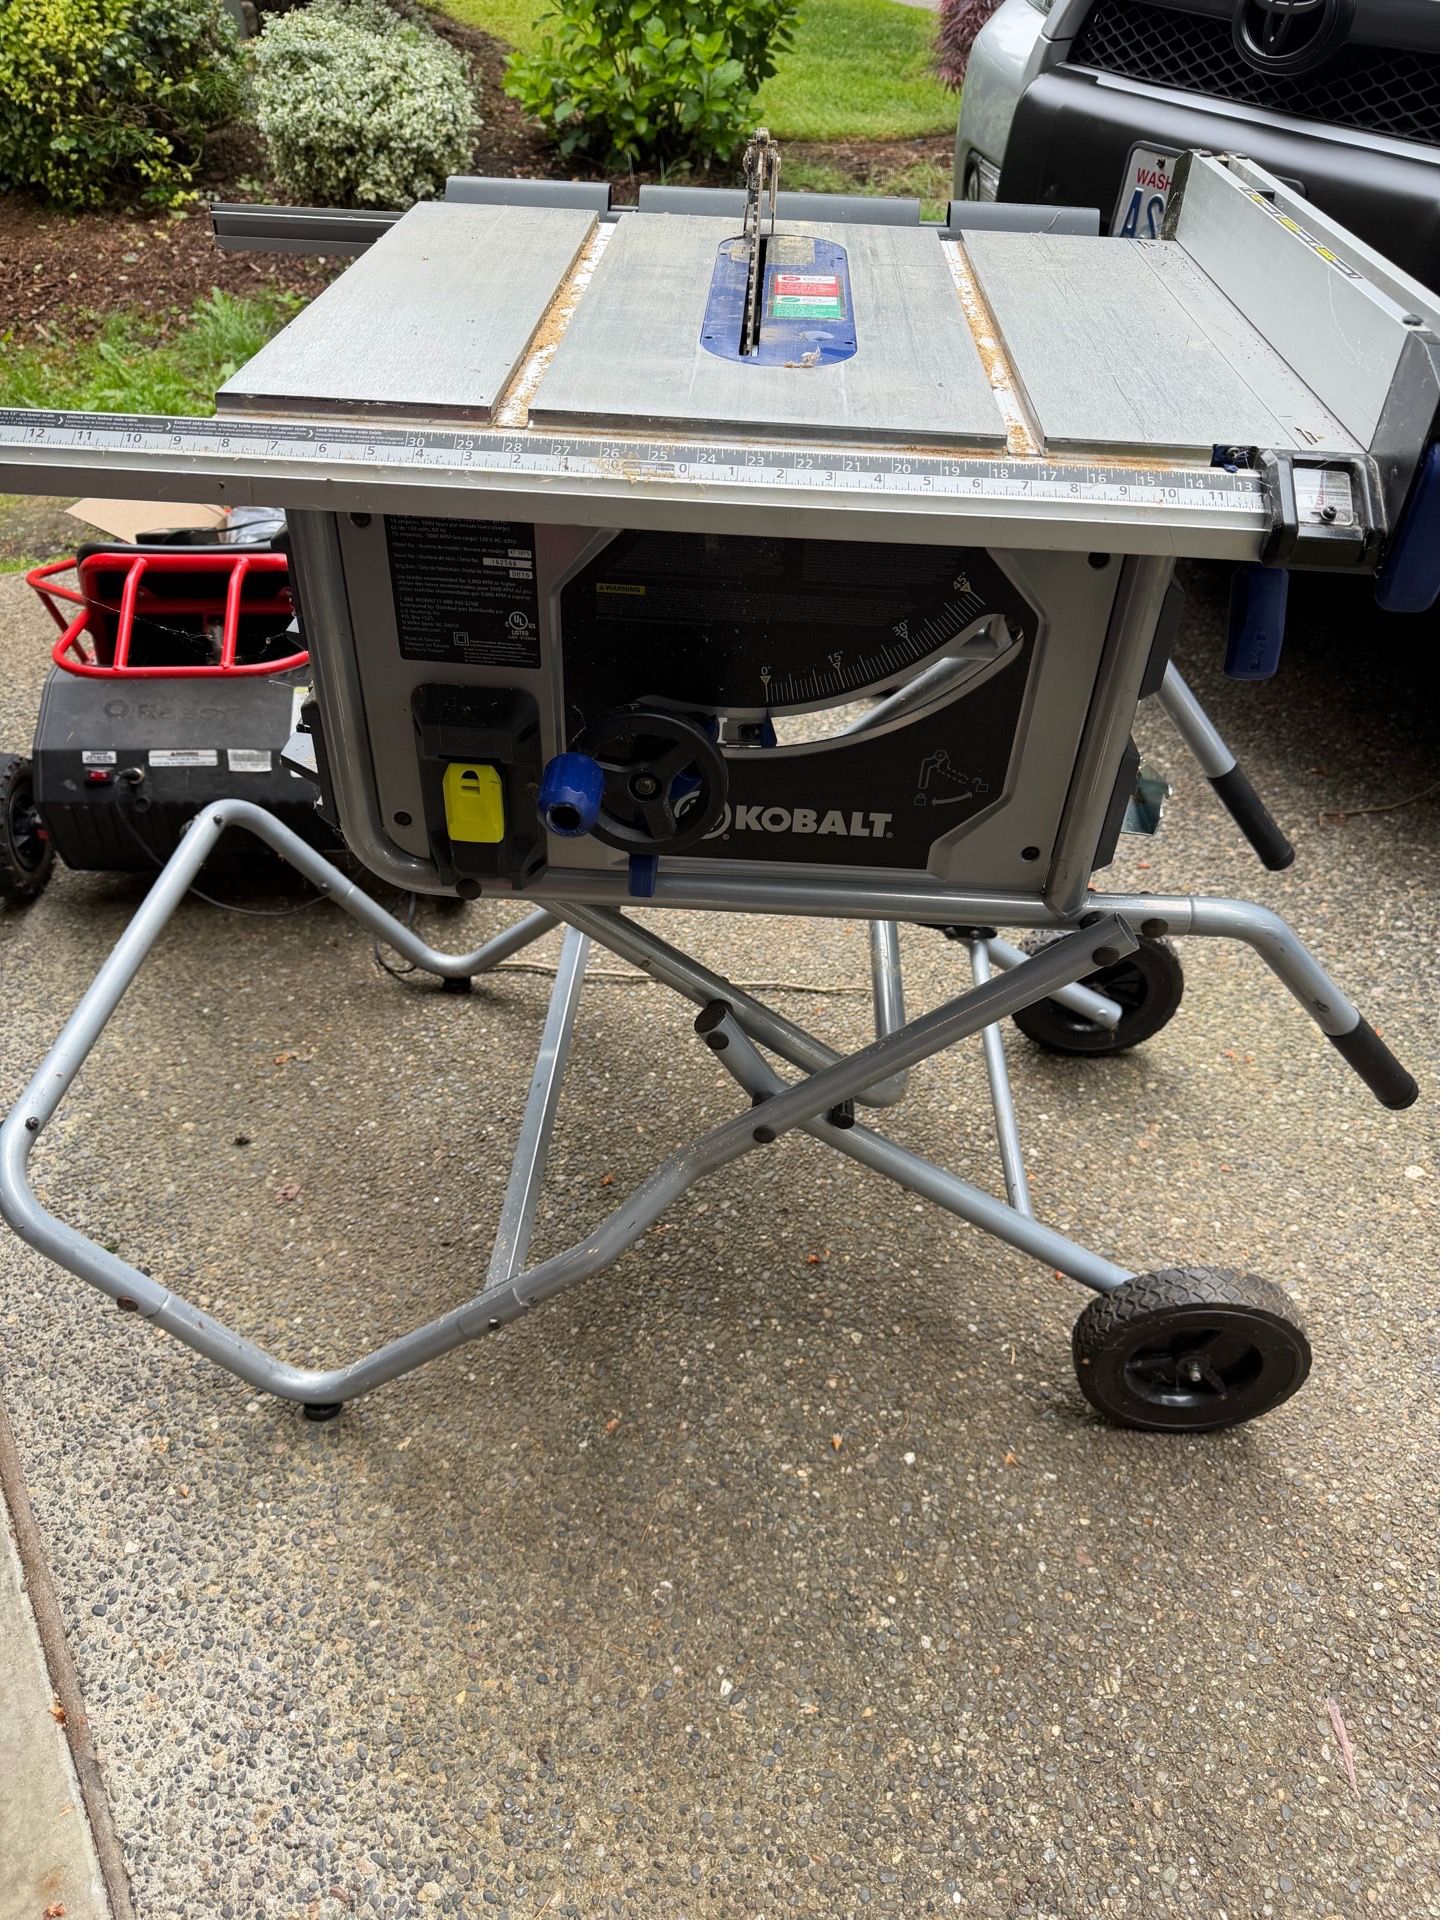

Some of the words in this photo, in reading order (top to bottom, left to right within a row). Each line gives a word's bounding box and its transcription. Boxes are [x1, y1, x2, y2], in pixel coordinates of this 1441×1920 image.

[29, 428, 45, 438] 12
[77, 431, 92, 440] 11
[125, 433, 142, 443] 10
[172, 435, 182, 445] 9
[221, 438, 230, 448] 8
[270, 440, 278, 450] 7
[318, 443, 327, 453] 6
[367, 446, 375, 455] 5
[415, 449, 424, 458] 4
[464, 451, 472, 461] 3
[512, 454, 521, 463] 2
[563, 457, 569, 465] 1
[407, 437, 425, 447] 30
[456, 440, 474, 450] 29
[504, 443, 522, 453] 28
[553, 445, 571, 455] 27
[602, 448, 619, 458] 26
[651, 451, 668, 461] 25
[699, 454, 717, 464] 24
[748, 456, 765, 466] 23
[797, 459, 813, 469] 22
[845, 461, 860, 471] 21
[894, 464, 911, 474] 20
[943, 466, 960, 476] 19
[992, 469, 1009, 478] 18
[1041, 471, 1057, 481] 17
[1090, 473, 1107, 484] 16
[1139, 476, 1156, 486] 15
[1188, 479, 1205, 489] 14
[1236, 482, 1253, 492] 13
[679, 464, 687, 473] 0
[728, 466, 734, 475] 1
[776, 469, 784, 478] 2
[825, 471, 833, 481] 3
[874, 474, 882, 483] 4
[924, 476, 931, 485] 5
[972, 479, 980, 488] 6
[1021, 481, 1028, 490] 7
[1070, 483, 1079, 493] 8
[1119, 486, 1128, 496] 9
[1160, 488, 1177, 498] 10
[1209, 491, 1224, 501] 11
[606, 585, 641, 593] WARNING
[892, 619, 908, 637] 30°
[827, 651, 843, 664] 15°
[761, 666, 771, 675] 0°
[735, 805, 893, 838] KOBALT
